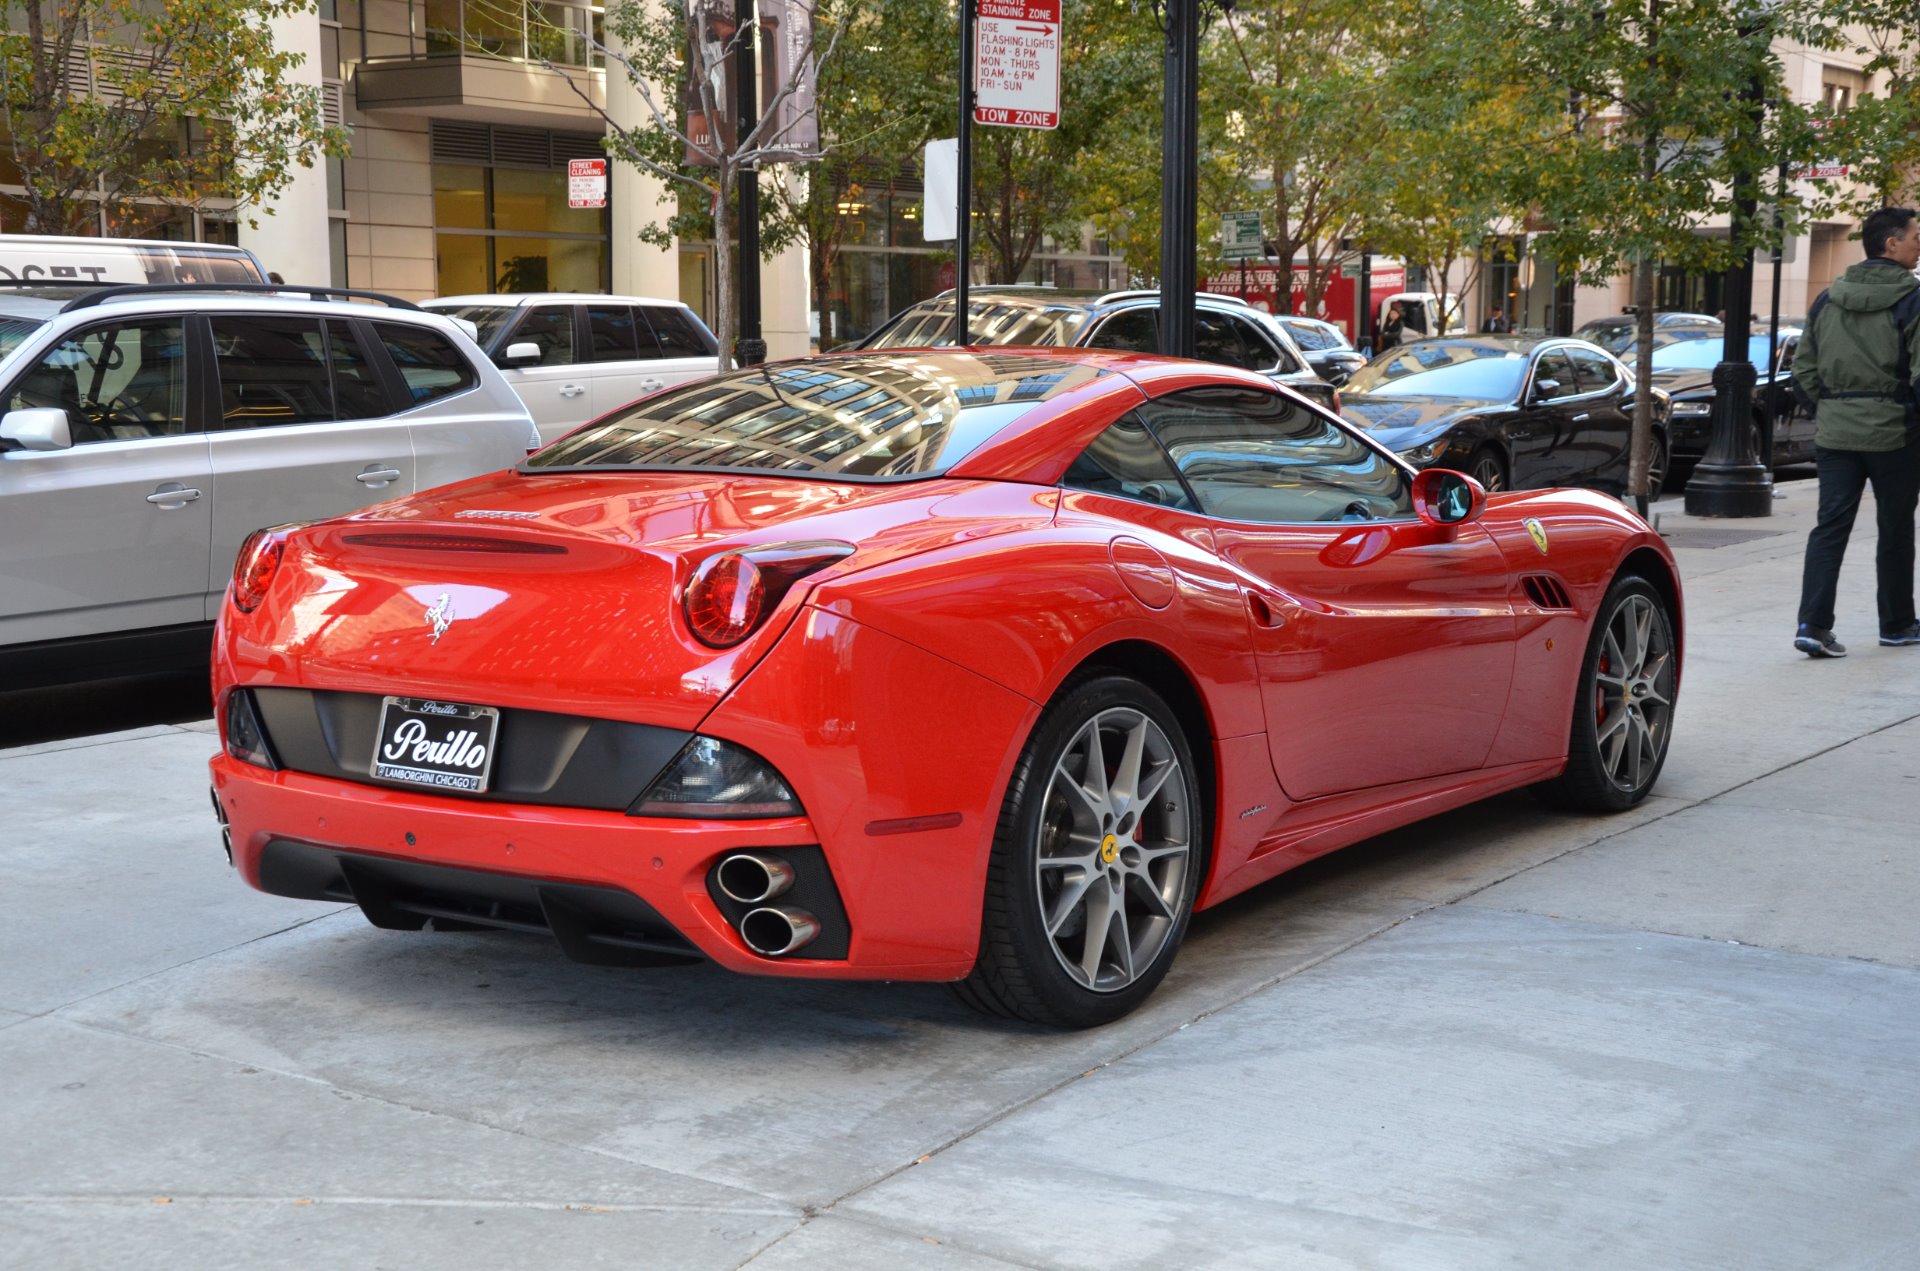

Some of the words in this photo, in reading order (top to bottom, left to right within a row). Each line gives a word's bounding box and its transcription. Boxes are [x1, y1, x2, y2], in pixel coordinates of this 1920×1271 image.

[982, 4, 1024, 17] STANDING
[1028, 8, 1051, 20] ZONE
[982, 22, 998, 33] USE
[982, 33, 1023, 47] FLASHING
[1025, 38, 1055, 50] LIGHTS
[981, 45, 990, 55] 10
[992, 46, 1005, 55] AM
[1015, 47, 1020, 57] 8
[1023, 48, 1036, 58] PM
[981, 56, 1000, 66] MON
[1011, 58, 1040, 70] THURS
[981, 67, 989, 77] 10
[991, 68, 1004, 78] AM
[1014, 70, 1019, 80] 6
[1022, 71, 1034, 80] PM
[980, 78, 995, 88] FRI
[1003, 80, 1022, 91] SUN
[980, 108, 1008, 122] TOW
[1015, 110, 1050, 126] ZONE
[571, 168, 601, 176] CLEANING
[1818, 167, 1842, 177] ZONE
[420, 701, 458, 715] Perillo
[384, 718, 486, 769] Perillo
[385, 767, 435, 783] LAMBORGHINI
[436, 774, 469, 788] CHICAGO
